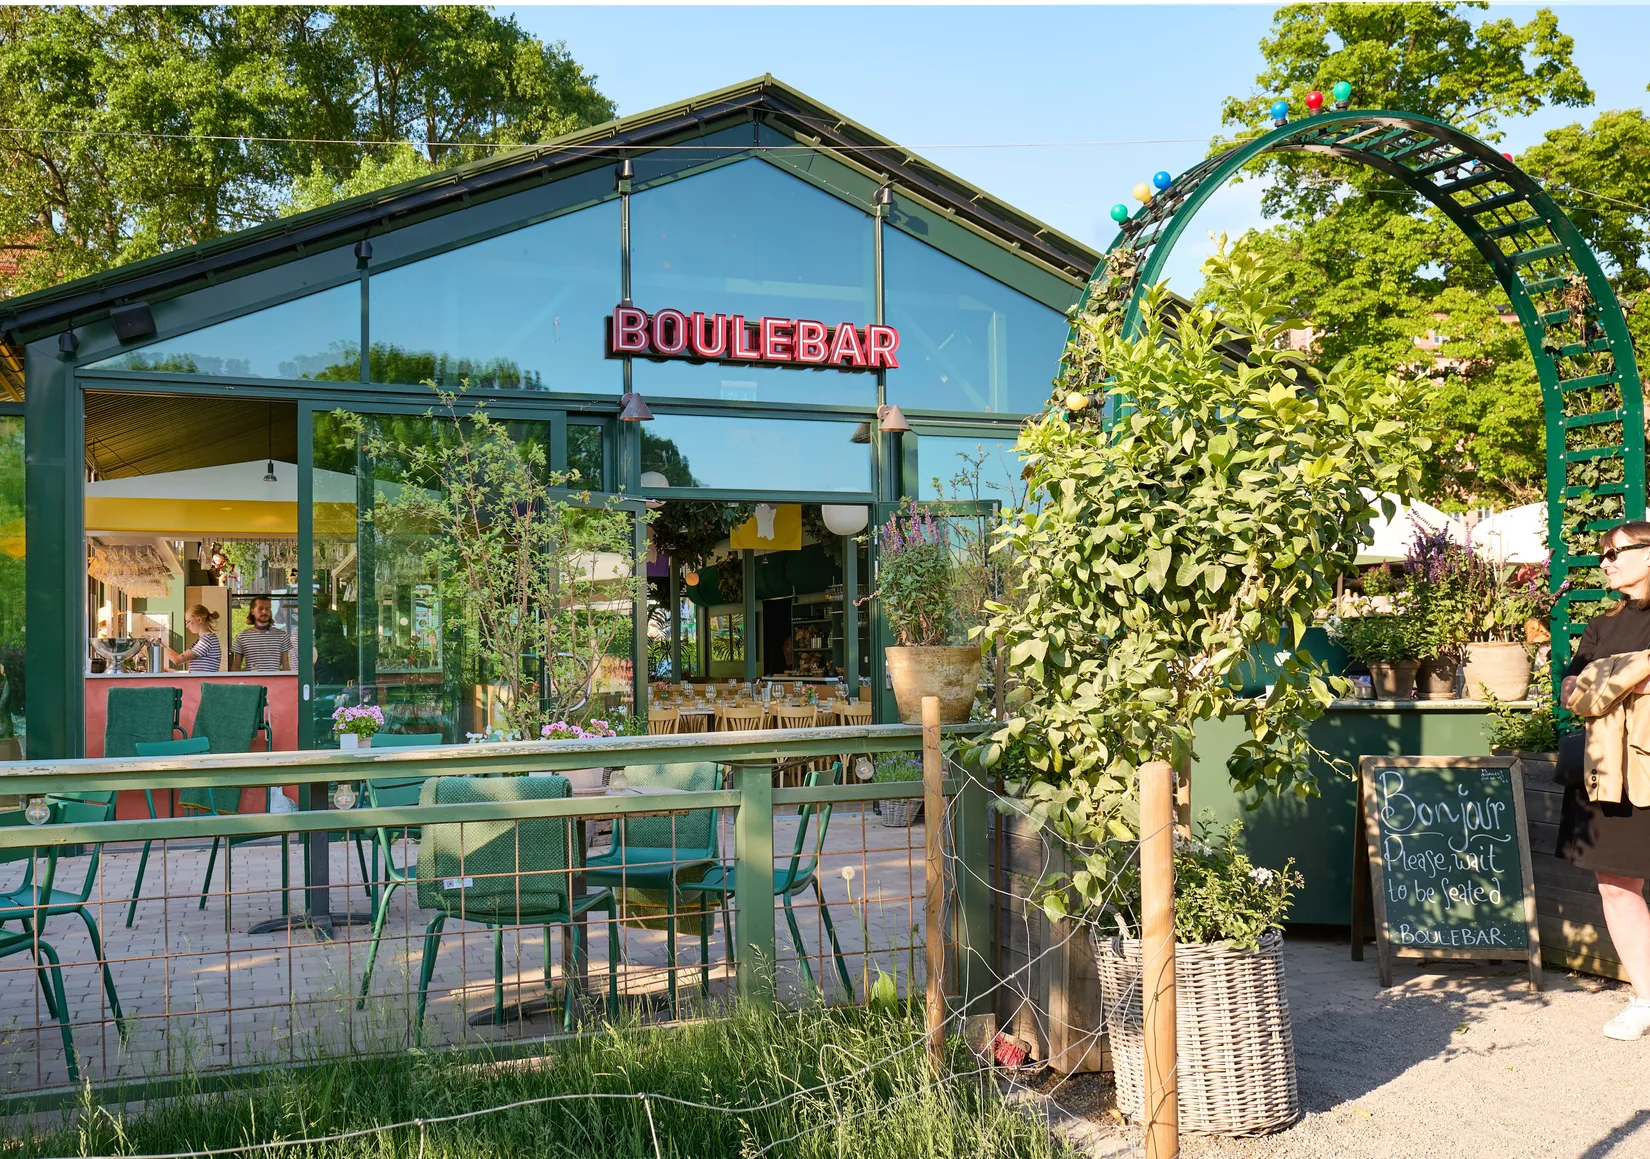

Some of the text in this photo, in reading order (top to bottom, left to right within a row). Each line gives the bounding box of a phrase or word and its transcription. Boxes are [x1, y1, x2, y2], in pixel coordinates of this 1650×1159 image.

[612, 306, 900, 369] BOULEBAR
[1379, 771, 1506, 852] Bonjour
[1384, 835, 1505, 879] Please, wait
[1388, 877, 1501, 910] to be seated
[1400, 923, 1507, 946] BOULEBAR
